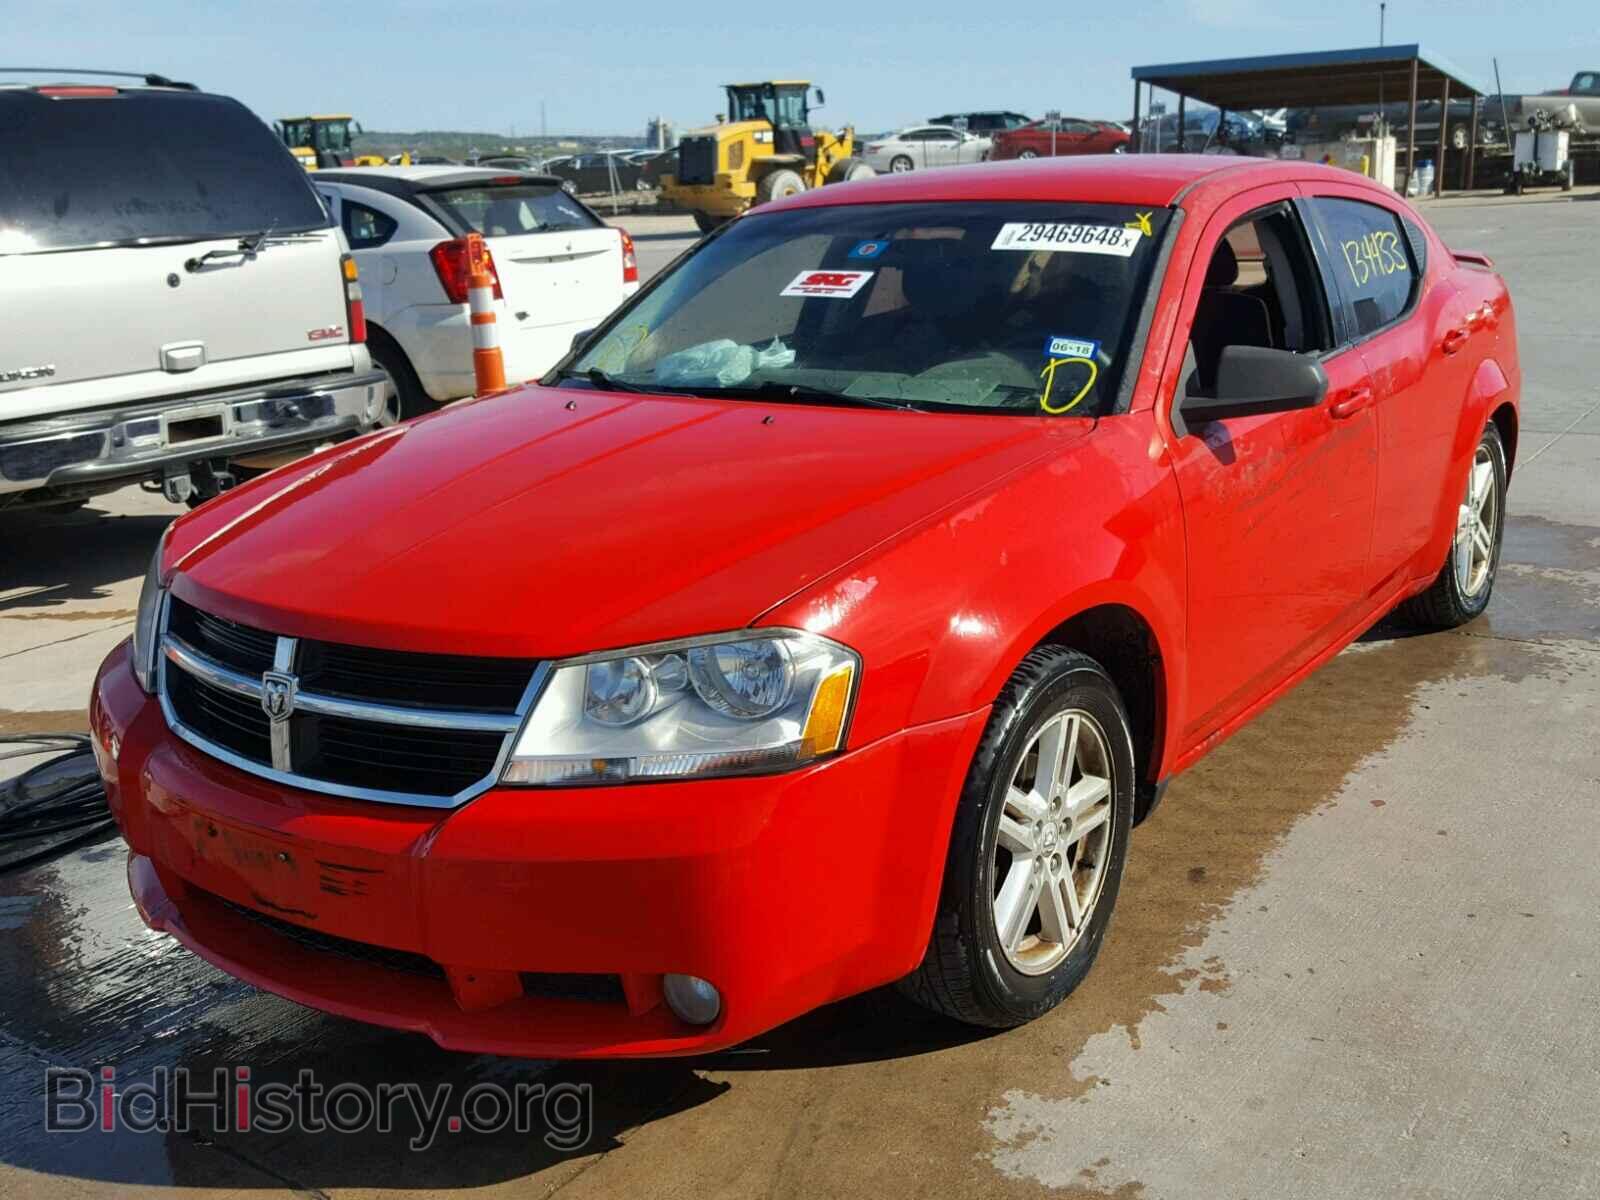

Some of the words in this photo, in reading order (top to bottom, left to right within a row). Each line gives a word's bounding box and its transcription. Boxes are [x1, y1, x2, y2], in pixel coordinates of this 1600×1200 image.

[1017, 223, 1124, 246] 29469648
[307, 325, 344, 341] GMC
[1052, 342, 1091, 355] 06-18
[1040, 357, 1098, 415] D
